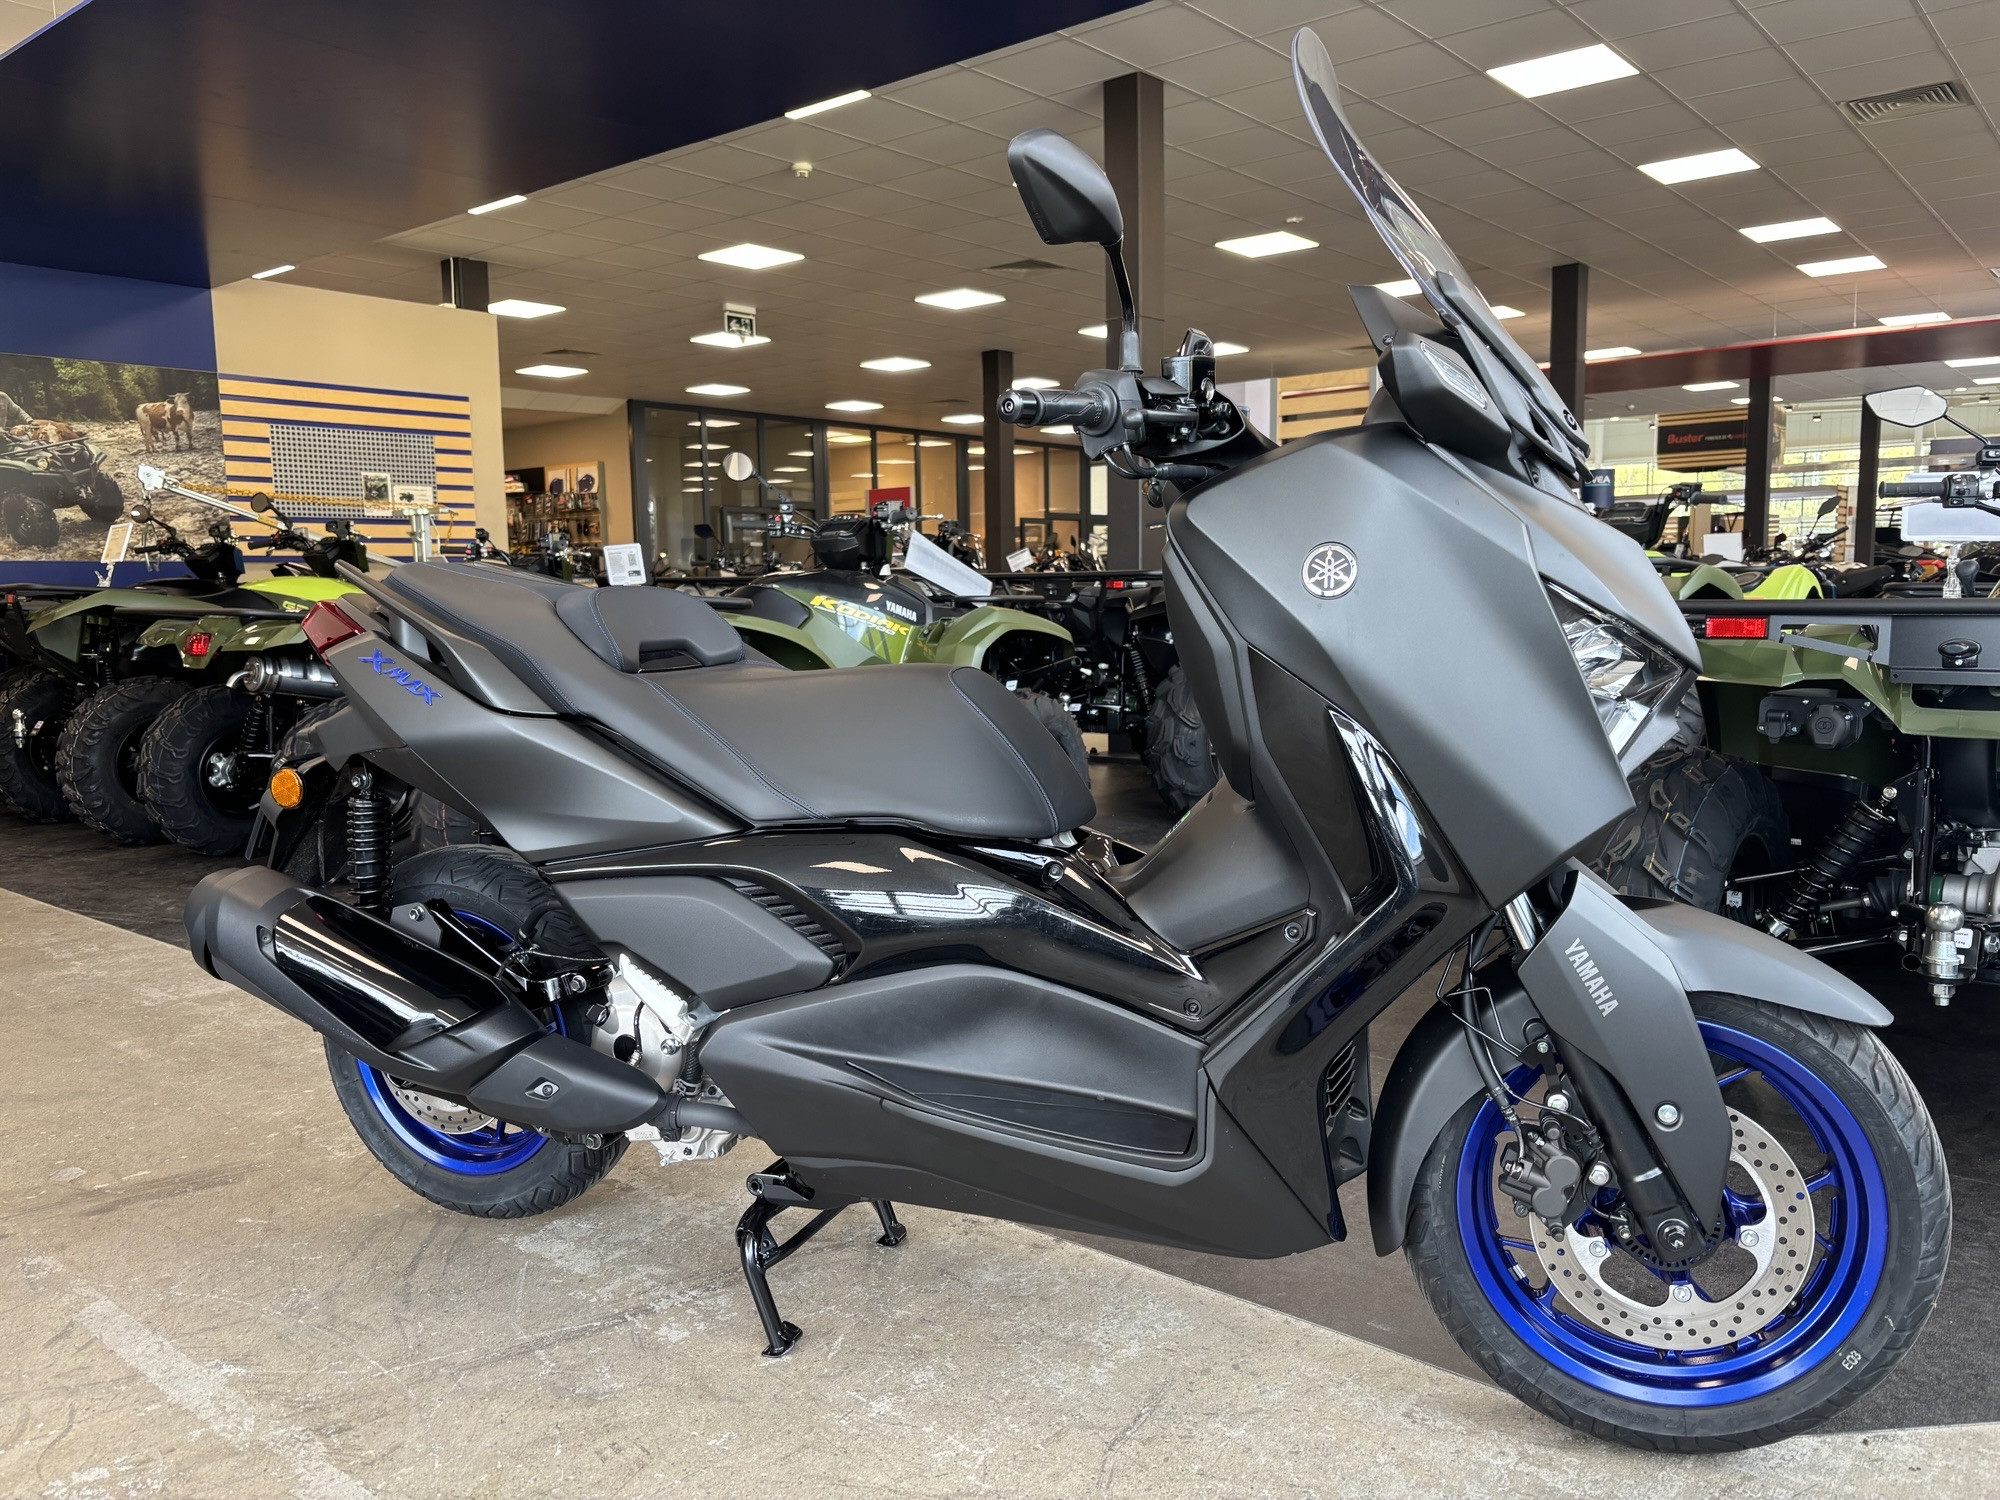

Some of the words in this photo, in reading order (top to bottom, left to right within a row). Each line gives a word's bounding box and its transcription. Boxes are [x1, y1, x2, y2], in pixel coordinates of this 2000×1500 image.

[1667, 433, 1705, 445] Buster
[809, 595, 910, 636] KODIAK
[885, 600, 917, 623] YAMAHA
[1564, 937, 1619, 1018] YAMAHA
